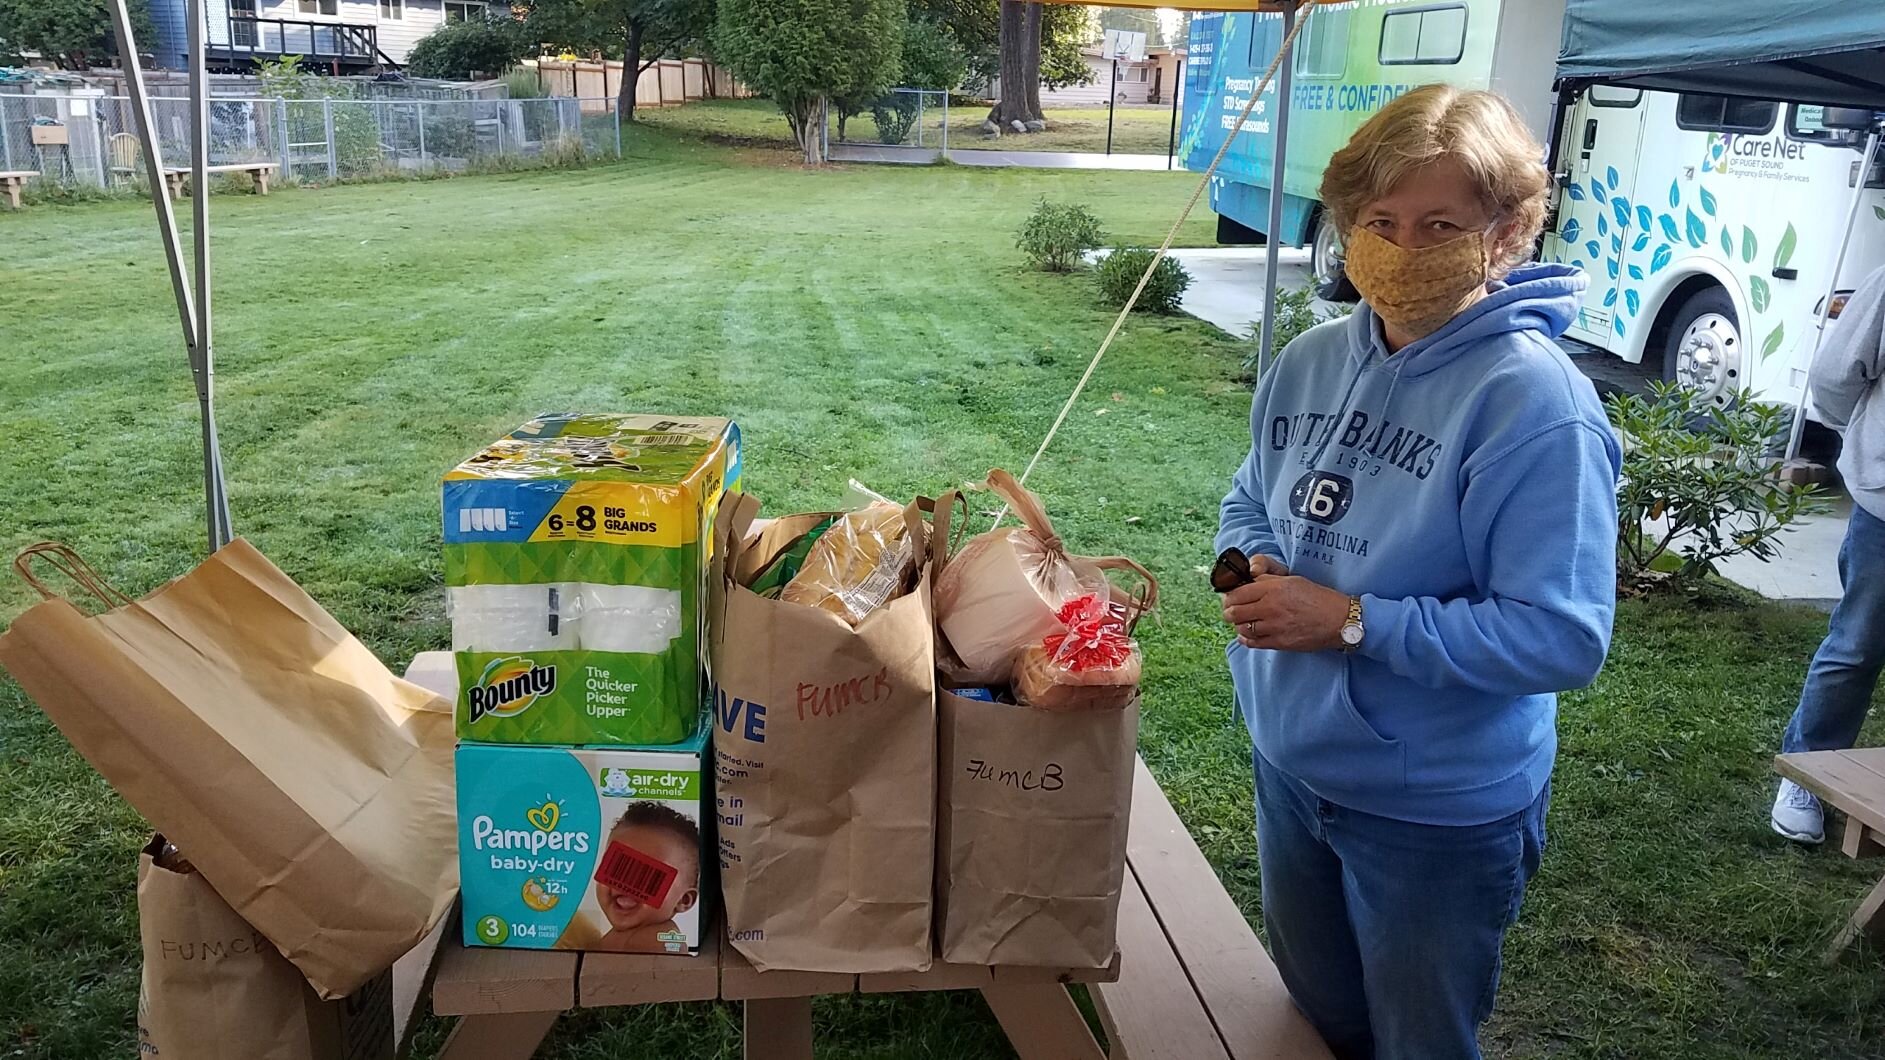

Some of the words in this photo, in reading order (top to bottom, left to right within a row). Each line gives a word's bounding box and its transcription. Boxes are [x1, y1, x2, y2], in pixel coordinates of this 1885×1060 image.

[1225, 76, 1254, 94] Pregnancy
[1254, 76, 1276, 94] Ting
[1223, 96, 1235, 110] STD
[1235, 97, 1266, 115] Screings
[1294, 85, 1324, 110] FREE
[1326, 85, 1334, 110] &
[1338, 84, 1427, 111] CONFIDE
[1221, 115, 1236, 130] FREE
[1236, 116, 1270, 134] rasounds
[1733, 134, 1772, 158] Care
[1773, 136, 1806, 161] Net
[1730, 158, 1739, 166] OF
[1740, 159, 1761, 168] PUGET
[1761, 160, 1784, 170] SOUND
[1728, 167, 1758, 179] Pregnancy
[1783, 173, 1810, 183] Services
[1271, 412, 1338, 452] OUT
[1338, 409, 1443, 481] BANKS
[1335, 452, 1382, 477] 1903
[1299, 477, 1340, 518] 16
[603, 506, 626, 519] BIG
[603, 519, 657, 533] GRANDS
[1295, 522, 1370, 557] CAROLINA
[585, 666, 610, 679] The
[469, 664, 556, 724] Bounty
[585, 678, 638, 693] Quicker
[585, 691, 628, 706] Picker
[586, 704, 628, 719] Upper
[745, 759, 764, 769] Visit
[631, 772, 689, 790] air-dry
[730, 796, 743, 808] in
[472, 815, 590, 856] Pampers
[490, 854, 576, 875] baby-dry
[485, 918, 500, 938] 3
[511, 923, 537, 938] 104
